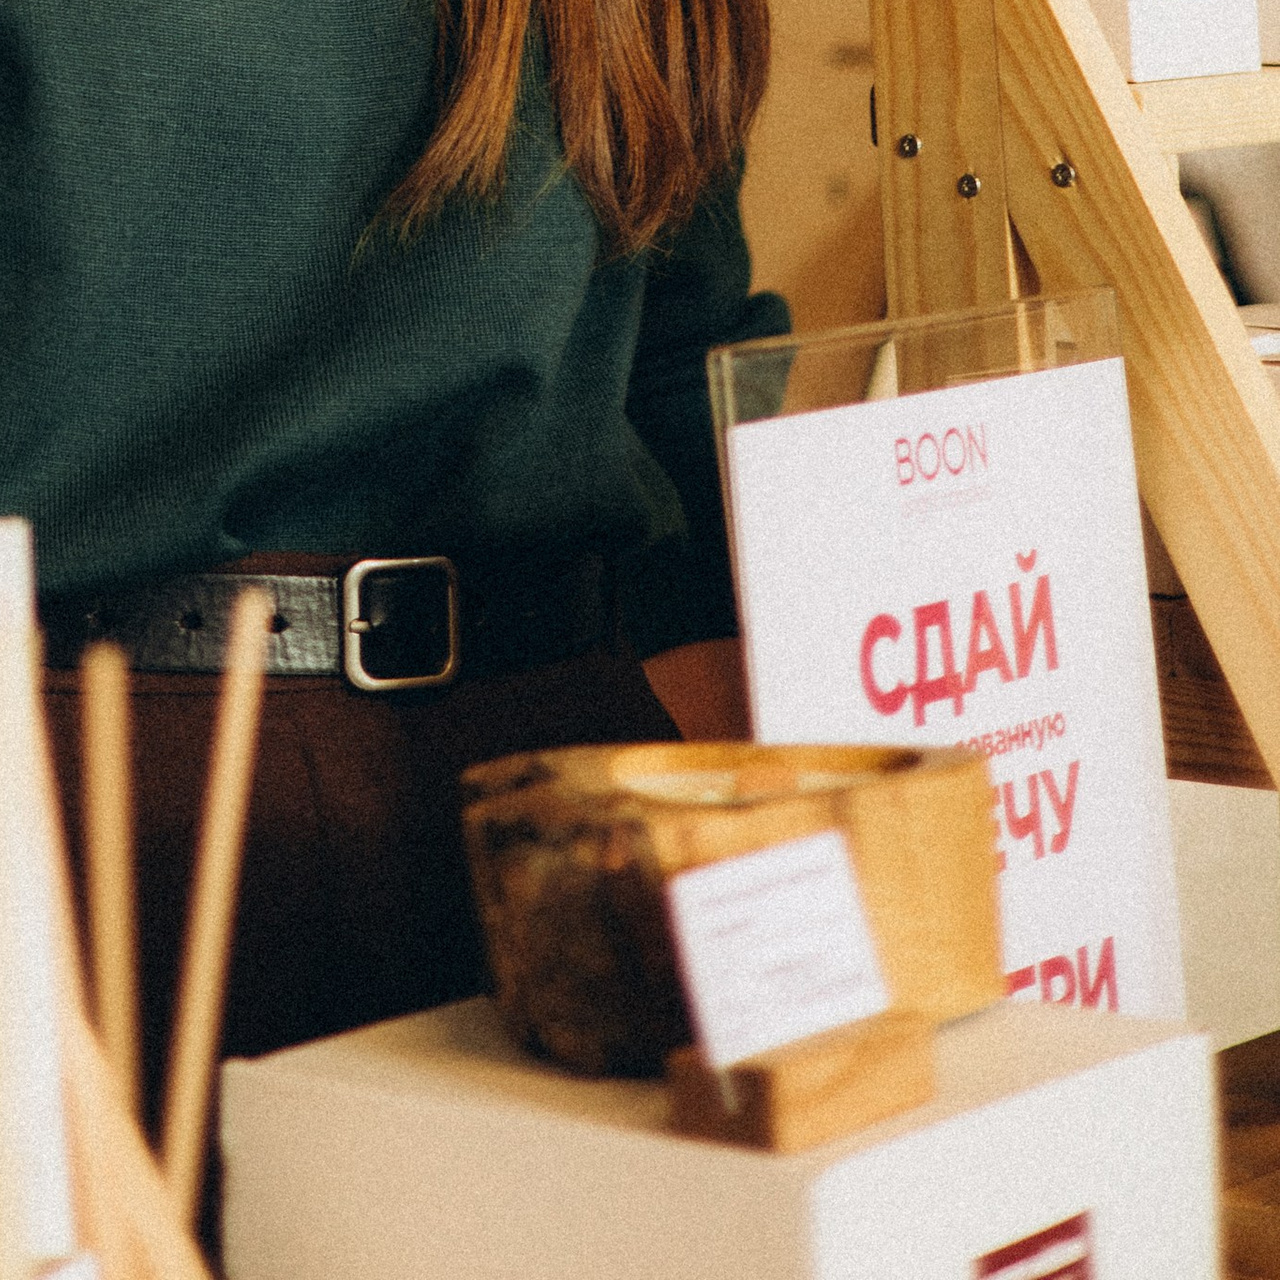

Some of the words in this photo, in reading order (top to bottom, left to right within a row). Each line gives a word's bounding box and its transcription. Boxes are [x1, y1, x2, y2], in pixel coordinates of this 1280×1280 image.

[894, 422, 989, 486] BOON
[858, 547, 1060, 728] СДАЙ
[990, 759, 1081, 873] ЧУ
